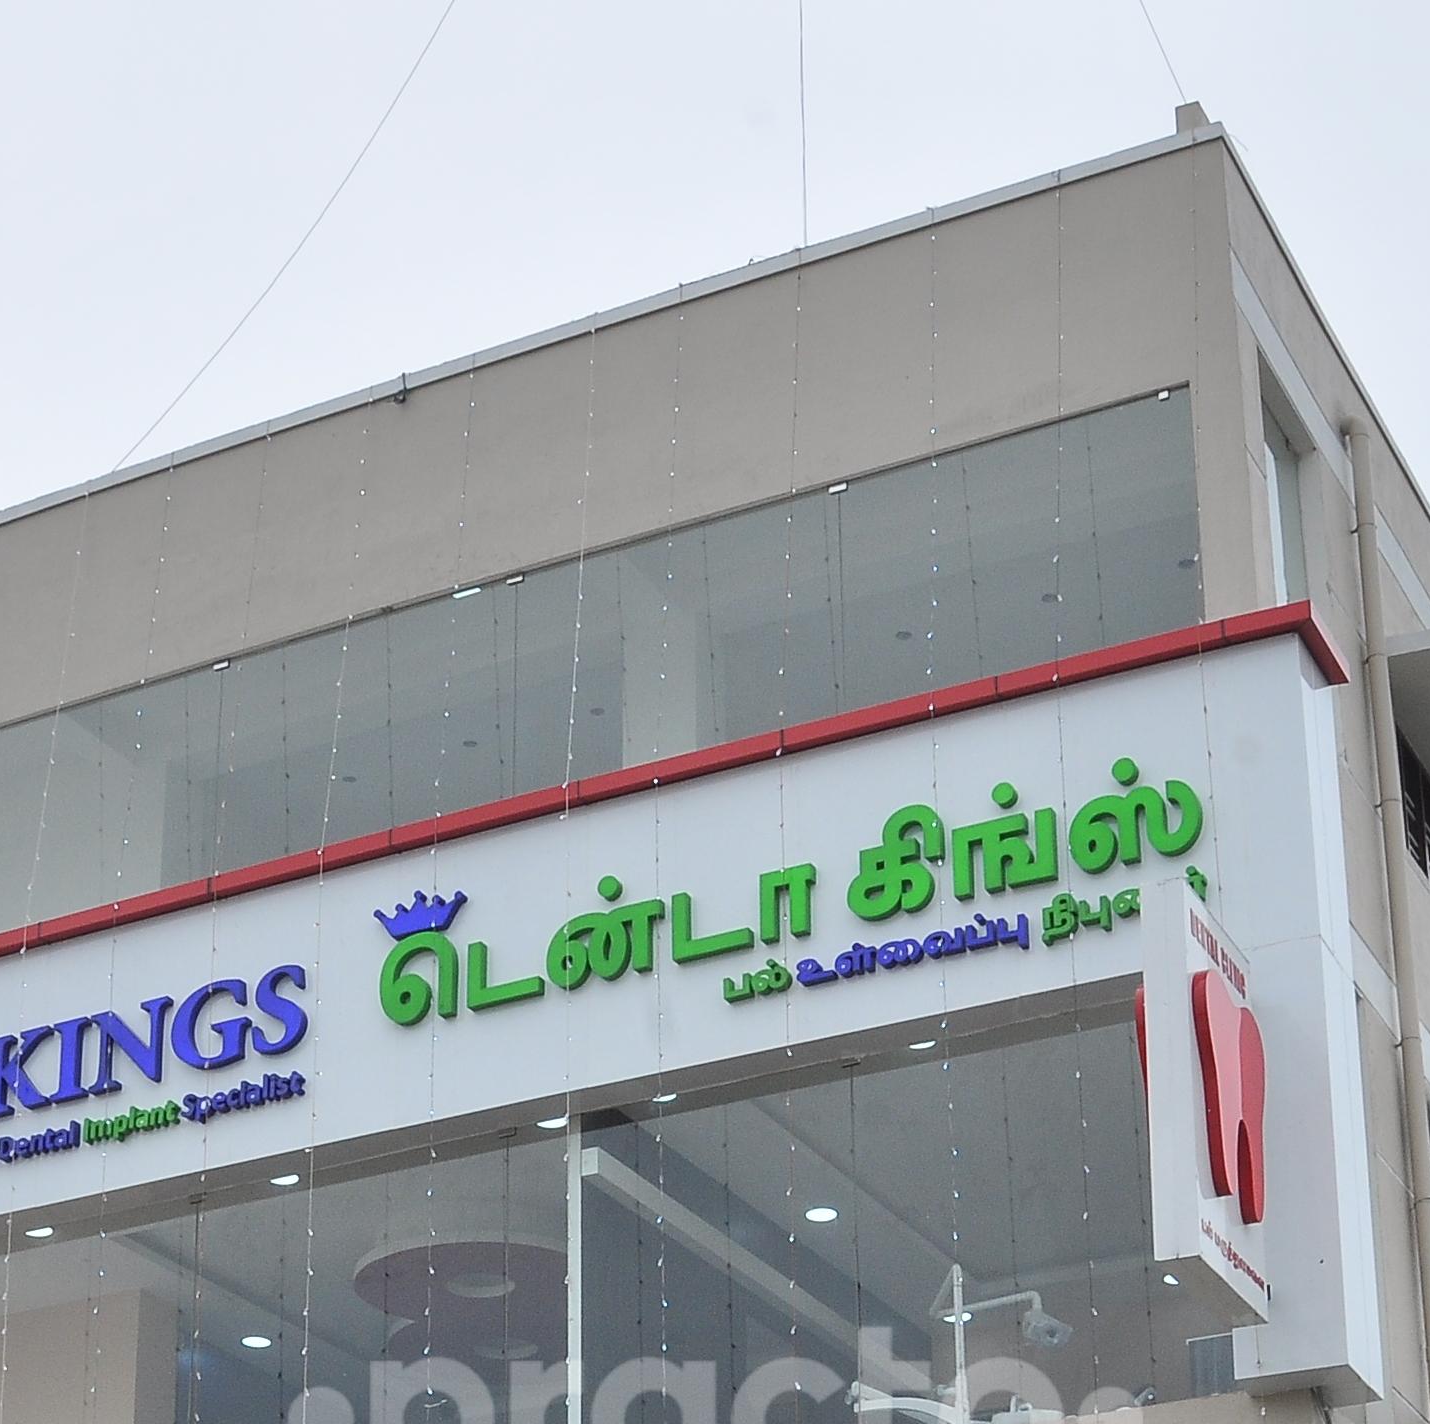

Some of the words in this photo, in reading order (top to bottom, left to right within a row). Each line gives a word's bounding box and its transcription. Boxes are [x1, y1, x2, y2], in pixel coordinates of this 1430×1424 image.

[377, 860, 817, 1027] டென்டா
[846, 757, 1204, 923] கிங்ஸ்
[723, 959, 792, 1003] பல்
[82, 1099, 181, 1146] Implant
[180, 1071, 307, 1123] Specialist
